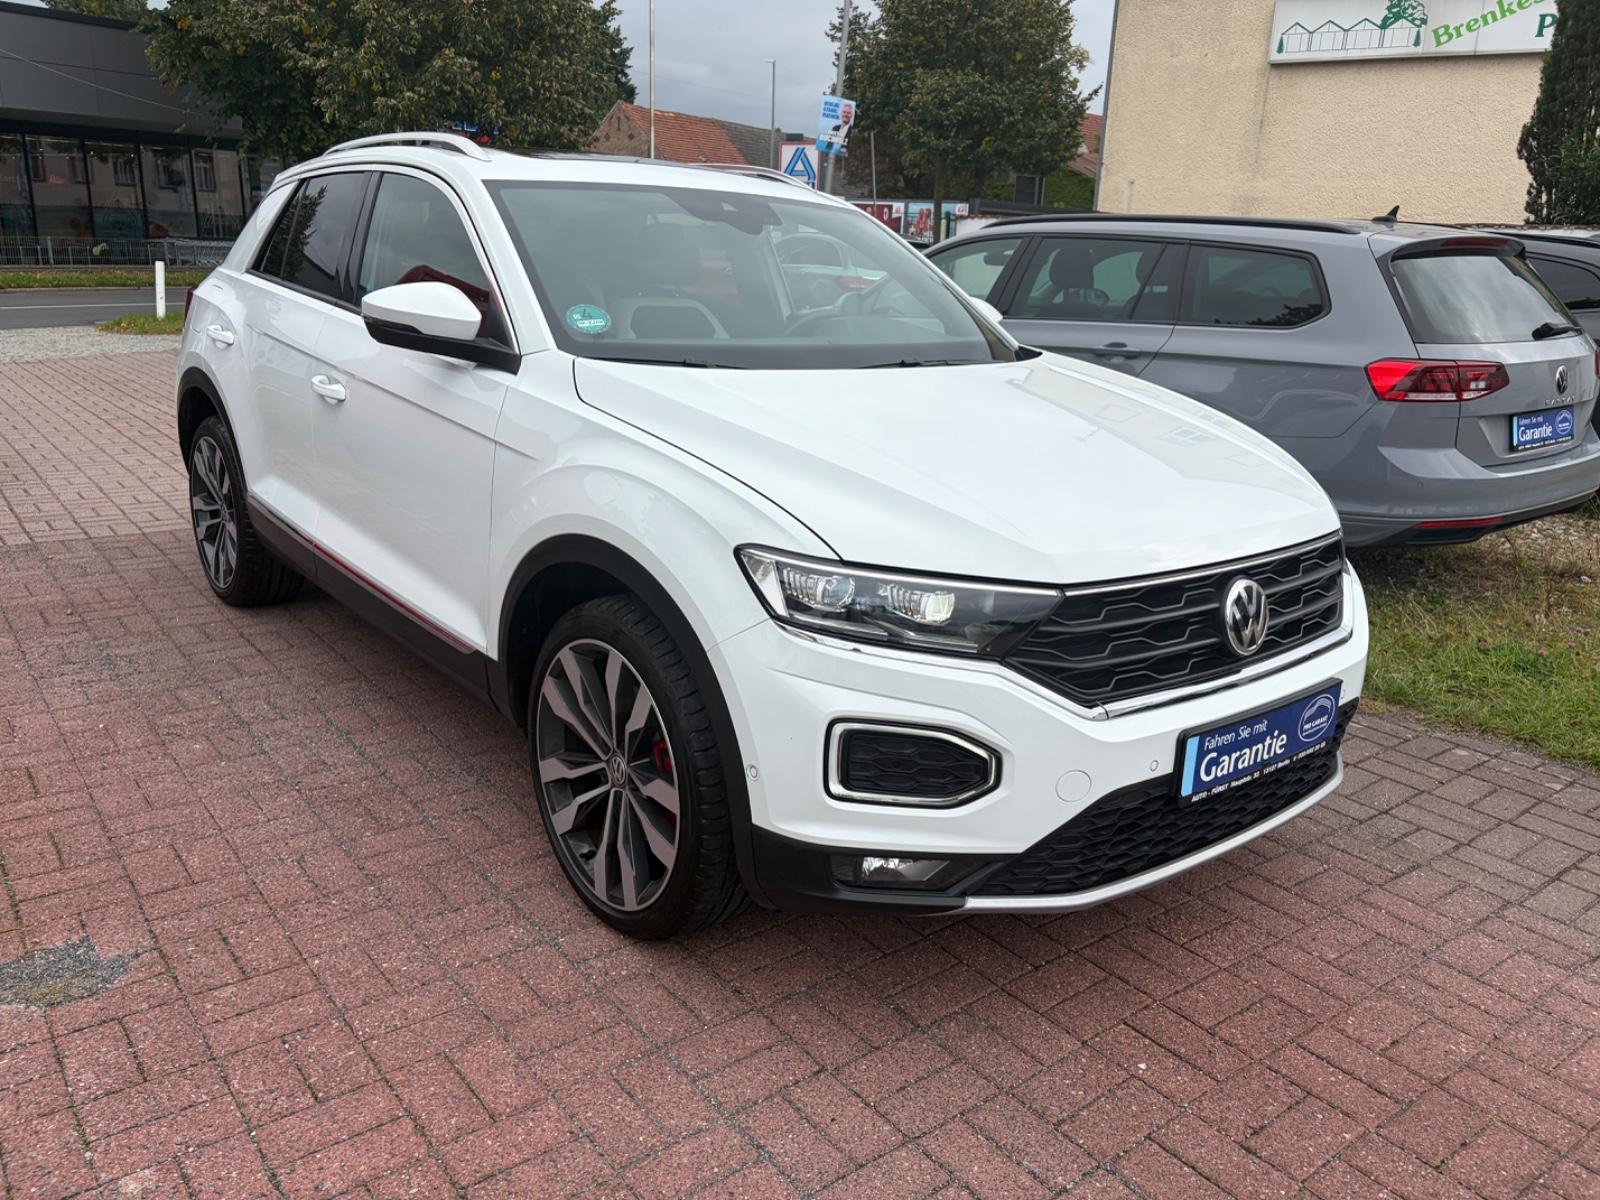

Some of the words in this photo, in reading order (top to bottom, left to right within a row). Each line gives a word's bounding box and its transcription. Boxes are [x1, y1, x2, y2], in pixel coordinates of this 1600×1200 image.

[1518, 422, 1553, 441] Garantie
[1204, 733, 1236, 751] Fahren
[1238, 725, 1252, 739] Sie
[1253, 719, 1268, 735] mit
[1200, 730, 1287, 782] Garantie
